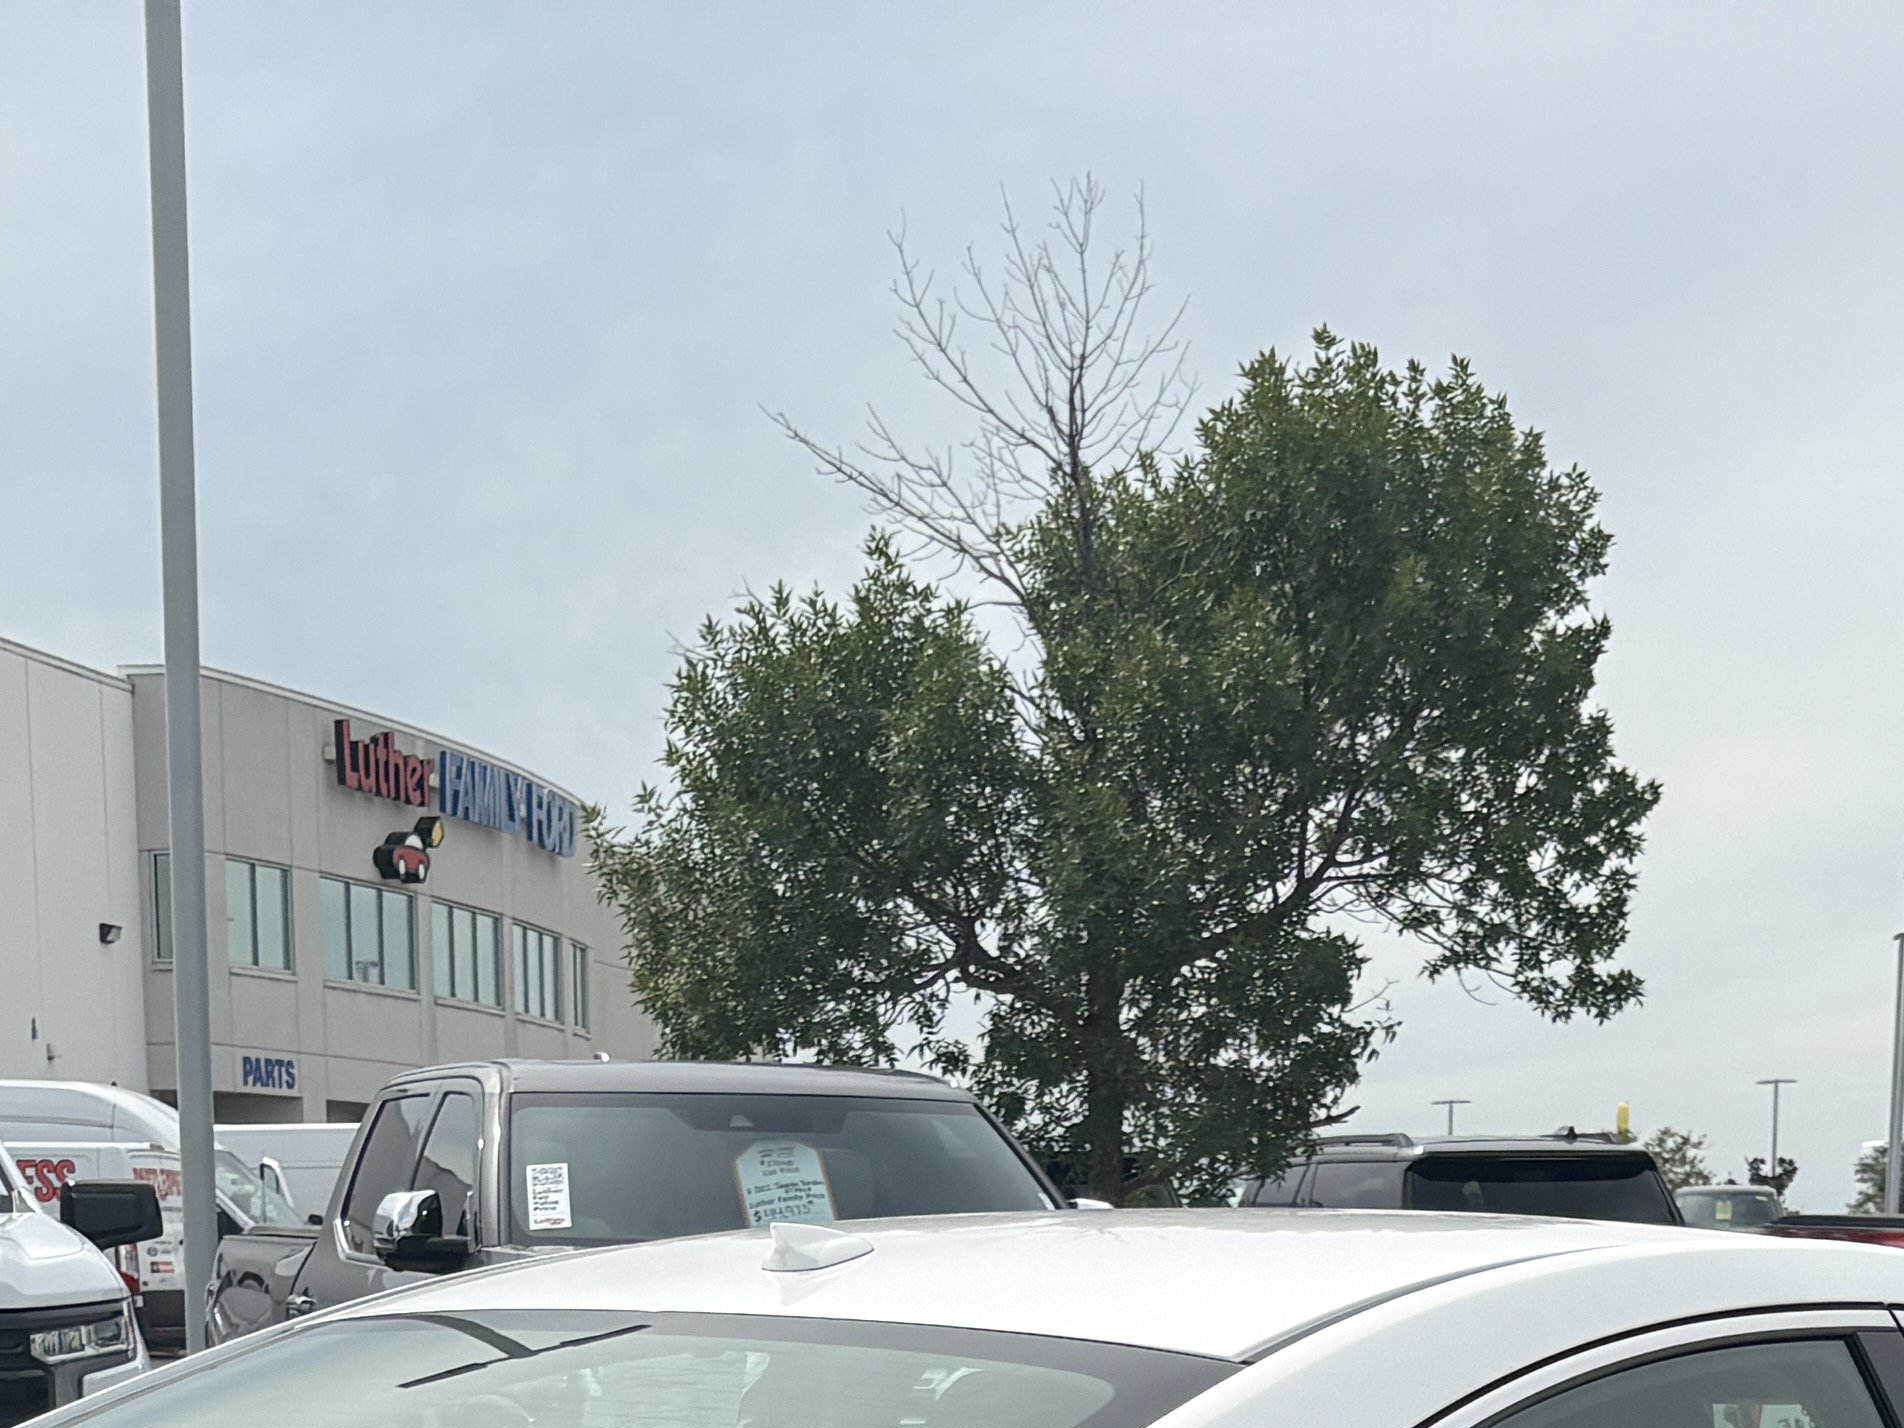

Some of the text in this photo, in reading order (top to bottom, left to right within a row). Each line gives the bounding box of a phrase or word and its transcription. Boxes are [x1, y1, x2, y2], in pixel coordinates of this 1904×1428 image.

[334, 718, 578, 859] Luther FAMILY FORD
[242, 1056, 296, 1090] PARTS
